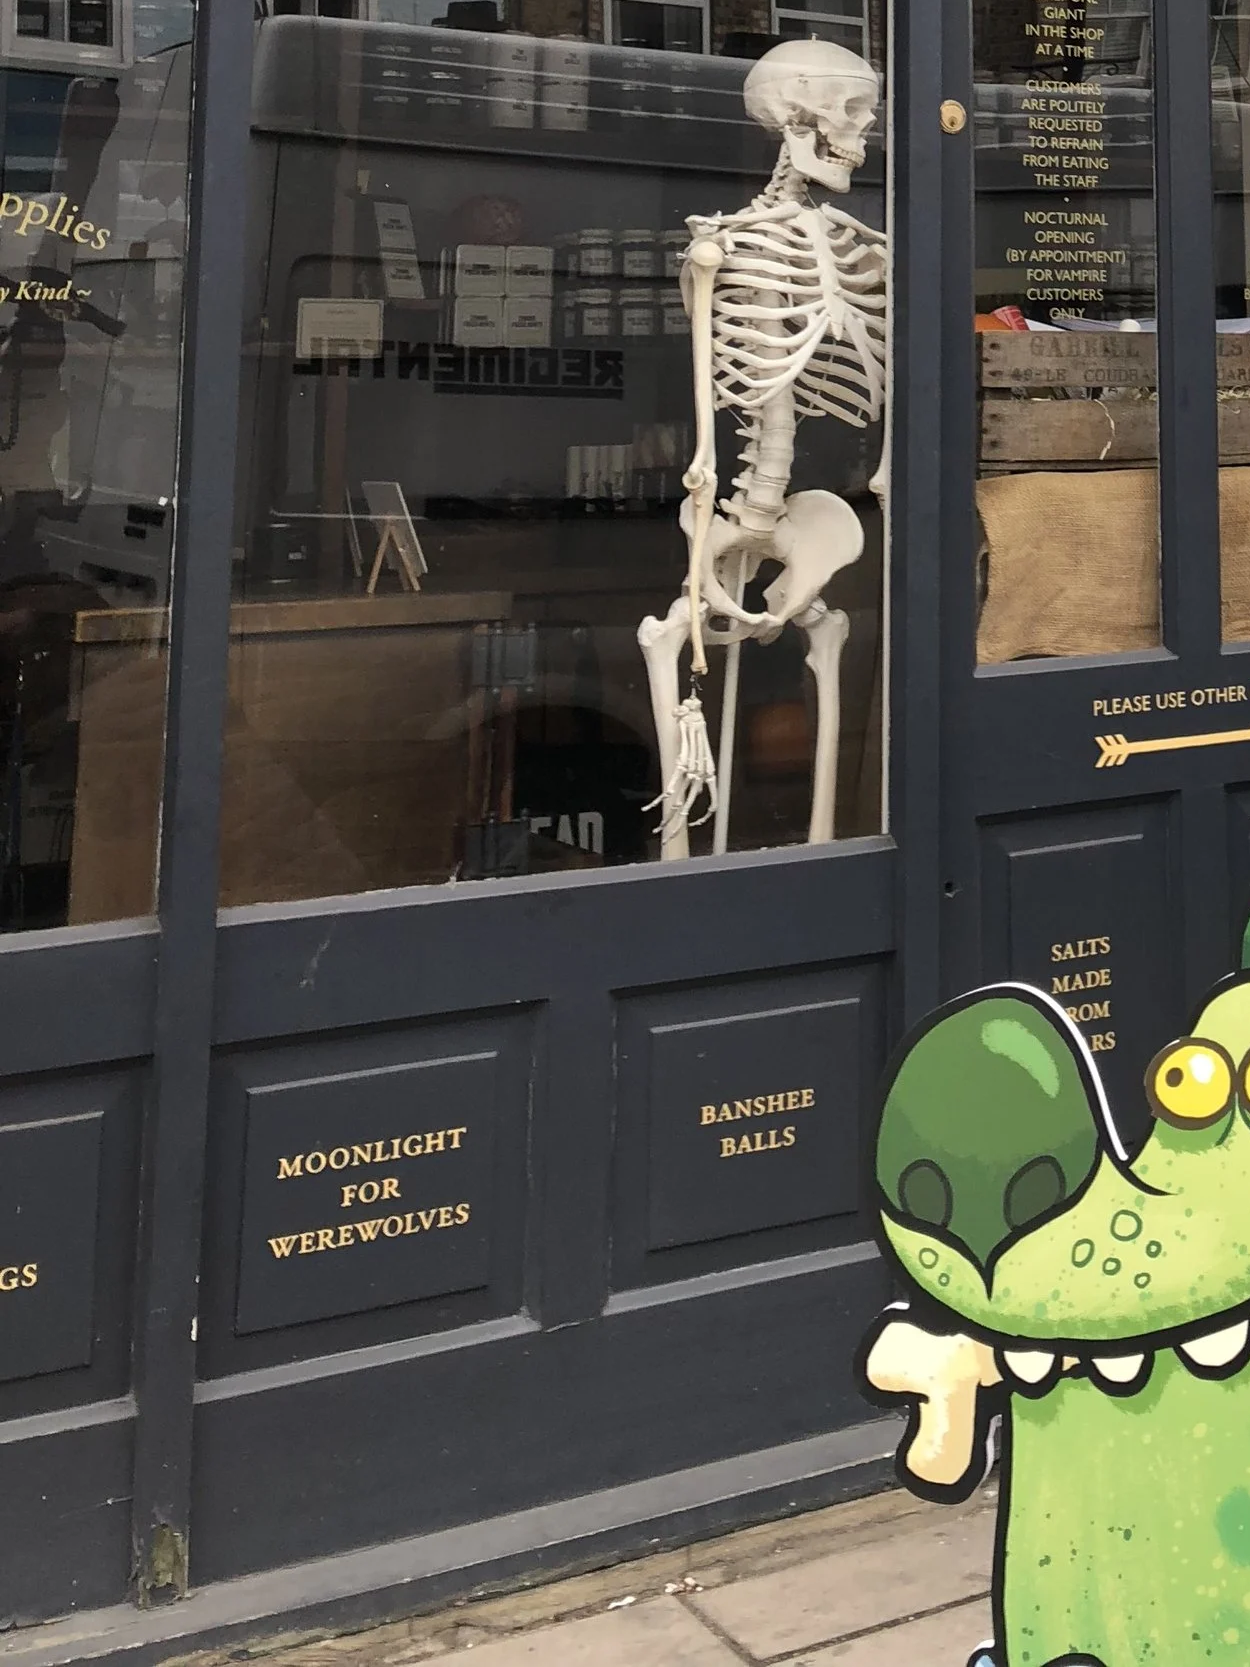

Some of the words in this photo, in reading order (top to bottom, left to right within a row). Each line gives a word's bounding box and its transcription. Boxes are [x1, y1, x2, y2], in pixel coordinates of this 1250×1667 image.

[1044, 7, 1086, 21] GIANT
[1025, 24, 1039, 36] IN
[1039, 25, 1067, 39] THE
[1070, 27, 1104, 41] SHOP
[1035, 43, 1052, 56] AT
[1054, 45, 1064, 56] A
[1065, 45, 1095, 59] TIME
[1026, 79, 1101, 96] CUSTOMERS
[1021, 98, 1046, 111] ARE
[1050, 100, 1106, 114] POLITELY
[1029, 117, 1102, 132] REQUESTED
[1029, 135, 1047, 149] TO
[1051, 136, 1103, 151] REFRAIN
[1023, 154, 1059, 168] FROM
[1062, 156, 1109, 170] EATING
[1034, 173, 1060, 187] THE
[1063, 174, 1099, 188] STAFF
[1024, 211, 1108, 226] NOCTURNAL
[1034, 230, 1095, 244] OPENING
[1006, 247, 1027, 263] (BY
[1028, 249, 1126, 265] APPOINTMENT)
[1026, 269, 1053, 282] FOR
[1055, 269, 1107, 283] VAMPIRE
[14, 280, 73, 301] Kind
[1026, 288, 1104, 302] CUSTOMERS
[1049, 307, 1086, 320] ONLY
[1093, 694, 1152, 717] PLEASE
[1155, 691, 1187, 710] USE
[1190, 685, 1248, 706] OTHER
[1051, 936, 1111, 962] SALTS
[1051, 968, 1112, 994] MADE
[1064, 1000, 1111, 1023] ROM
[700, 1088, 815, 1125] BANSHEE
[720, 1125, 796, 1157] BALLS
[276, 1127, 467, 1180] MOONLIGHT
[340, 1177, 401, 1208] FOR
[267, 1203, 470, 1259] WEREWOLVES
